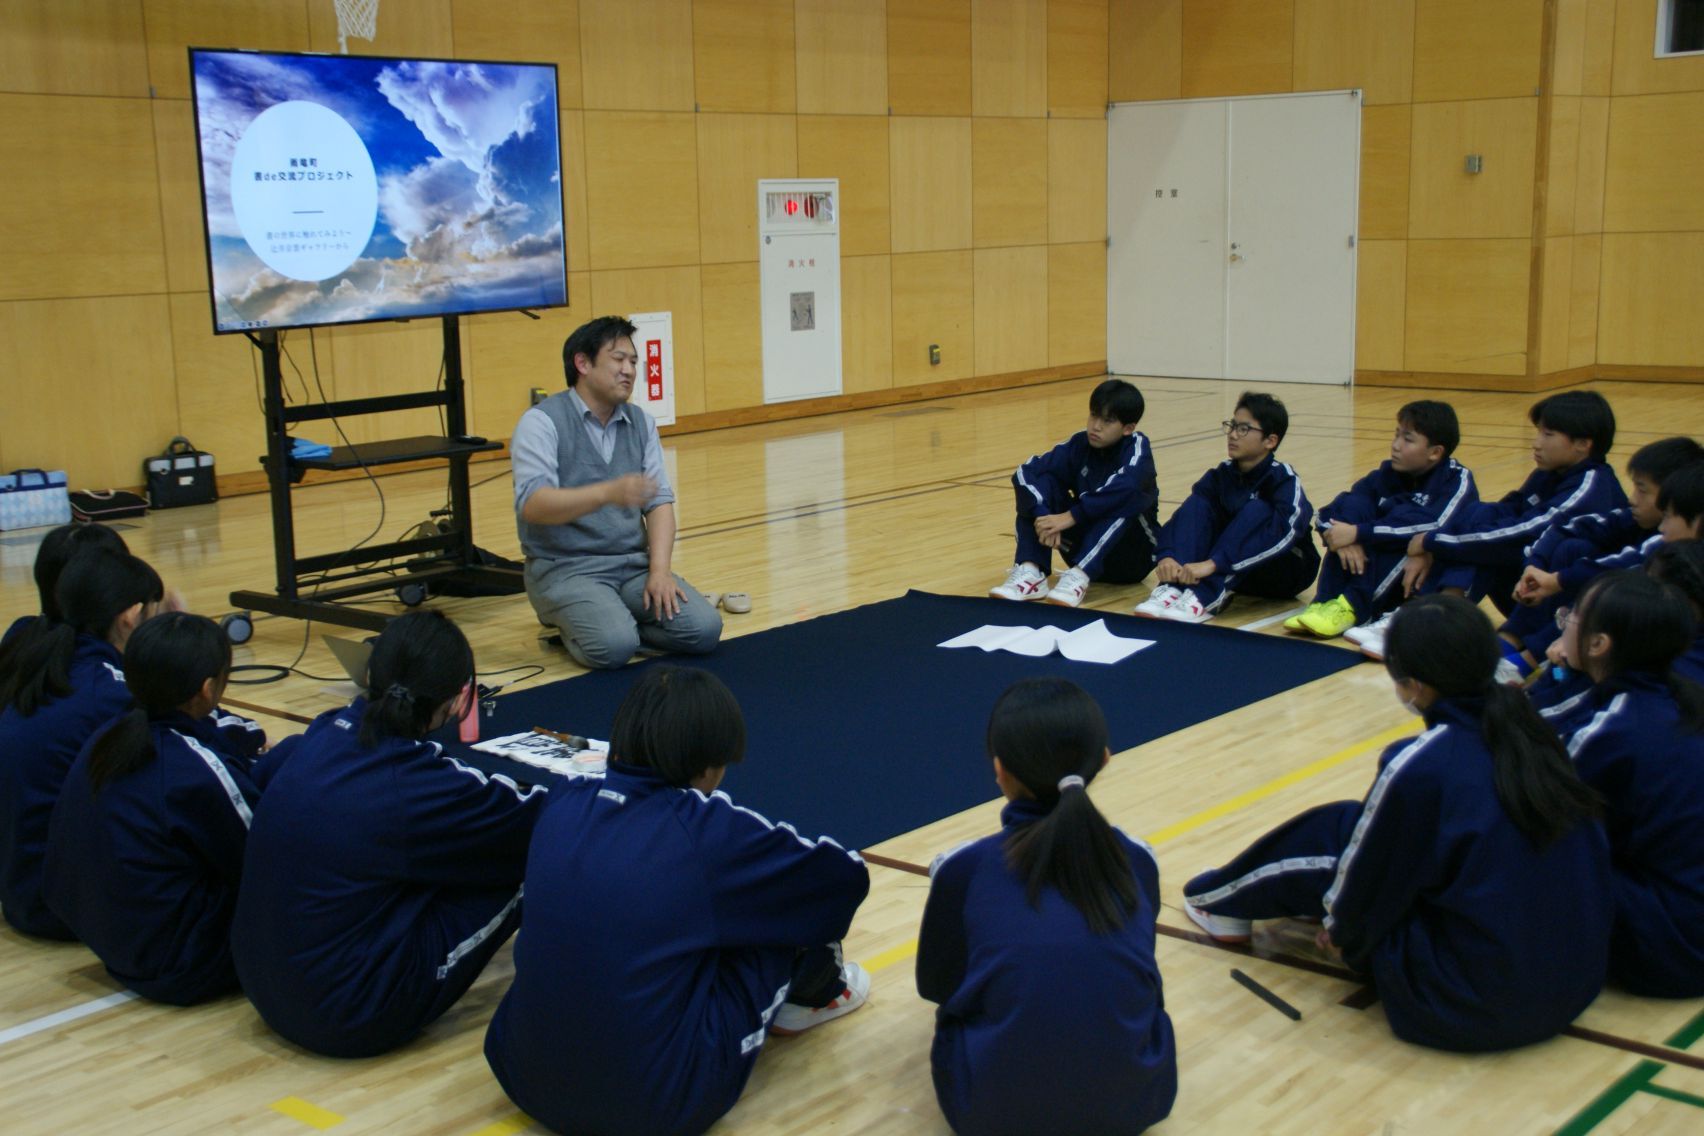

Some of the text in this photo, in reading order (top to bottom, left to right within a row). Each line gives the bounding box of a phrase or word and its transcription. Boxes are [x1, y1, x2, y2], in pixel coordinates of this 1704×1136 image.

[254, 171, 353, 181] 書de交流プロジェクト
[649, 343, 660, 397] 消火器
